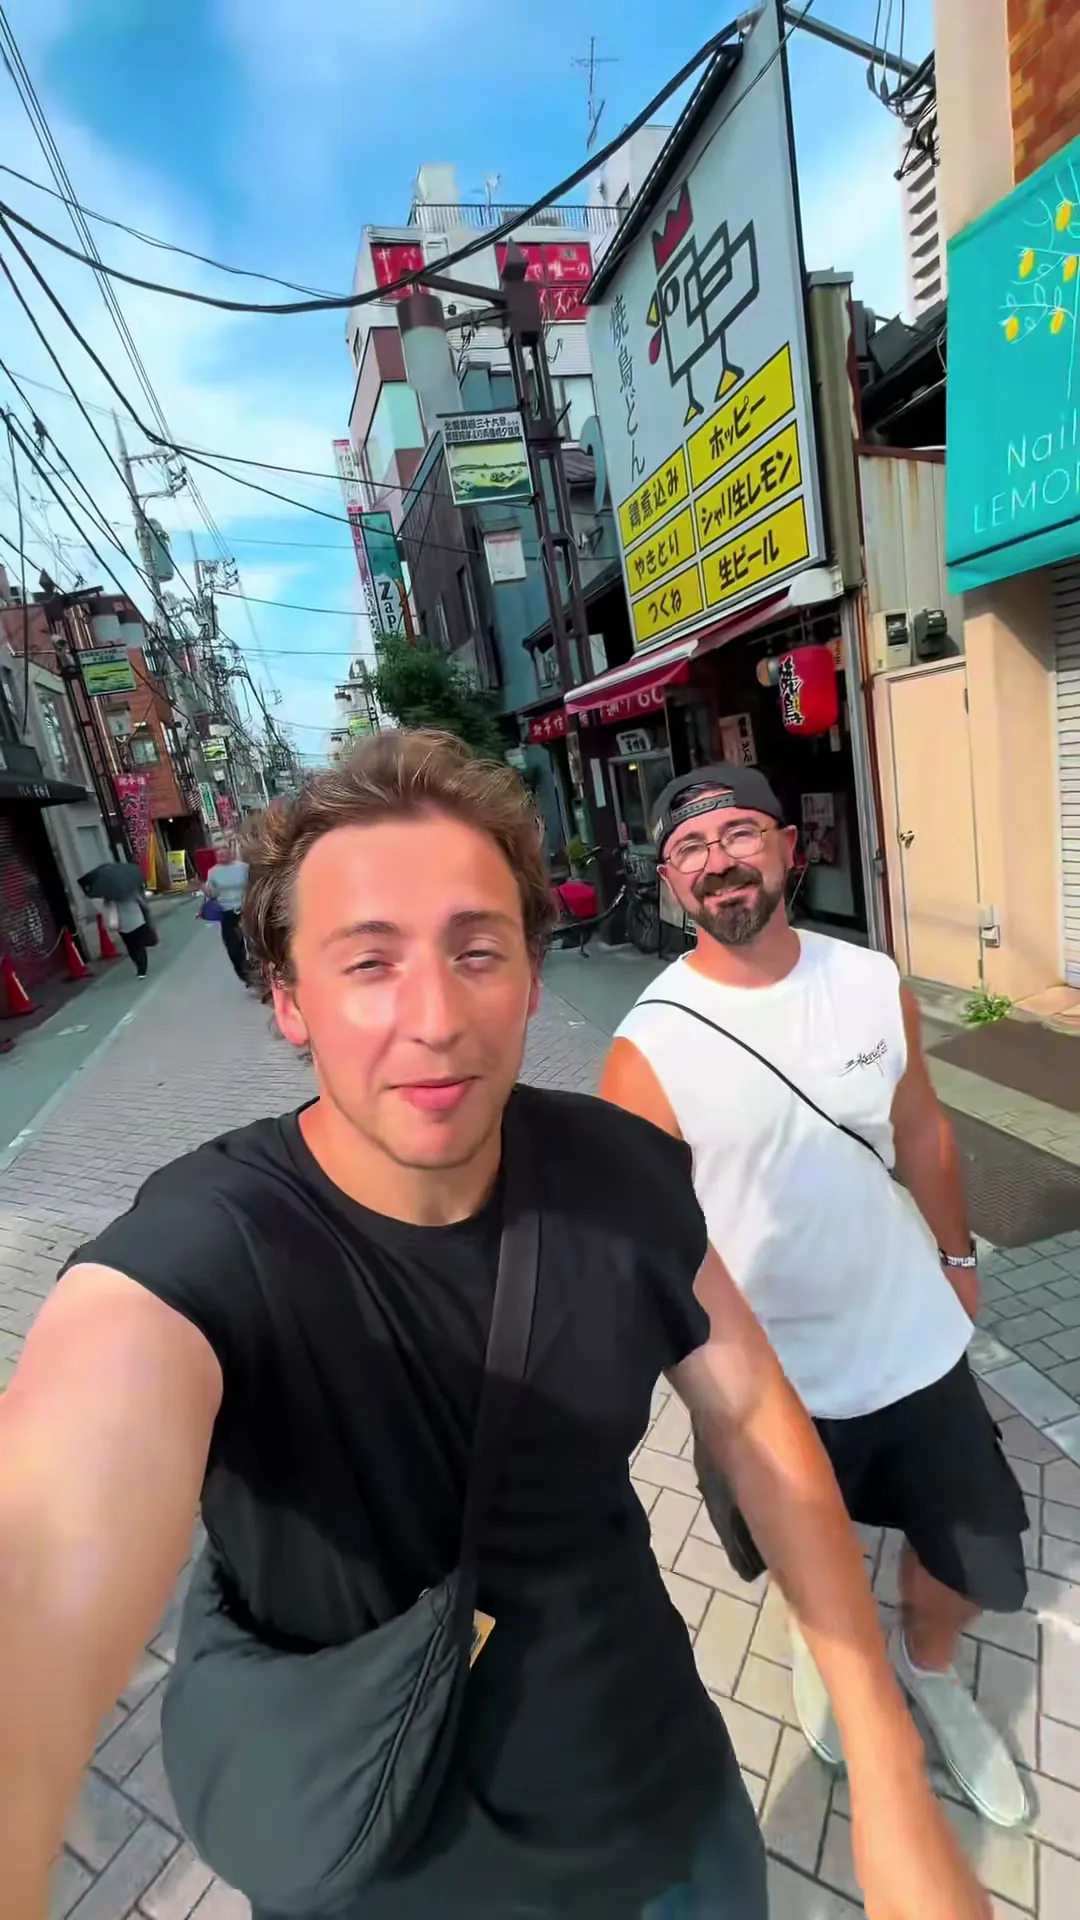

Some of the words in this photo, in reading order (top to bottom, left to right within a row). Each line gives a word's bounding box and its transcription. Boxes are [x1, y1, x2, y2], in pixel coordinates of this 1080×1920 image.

[609, 294, 646, 483] 焼鳥どん
[708, 395, 767, 461] ホッピー
[1007, 407, 1077, 475] Nail
[701, 449, 793, 537] シャリ生レモン
[634, 528, 680, 582] やきとり
[714, 529, 780, 591] 生ビール
[648, 588, 682, 623] つくね
